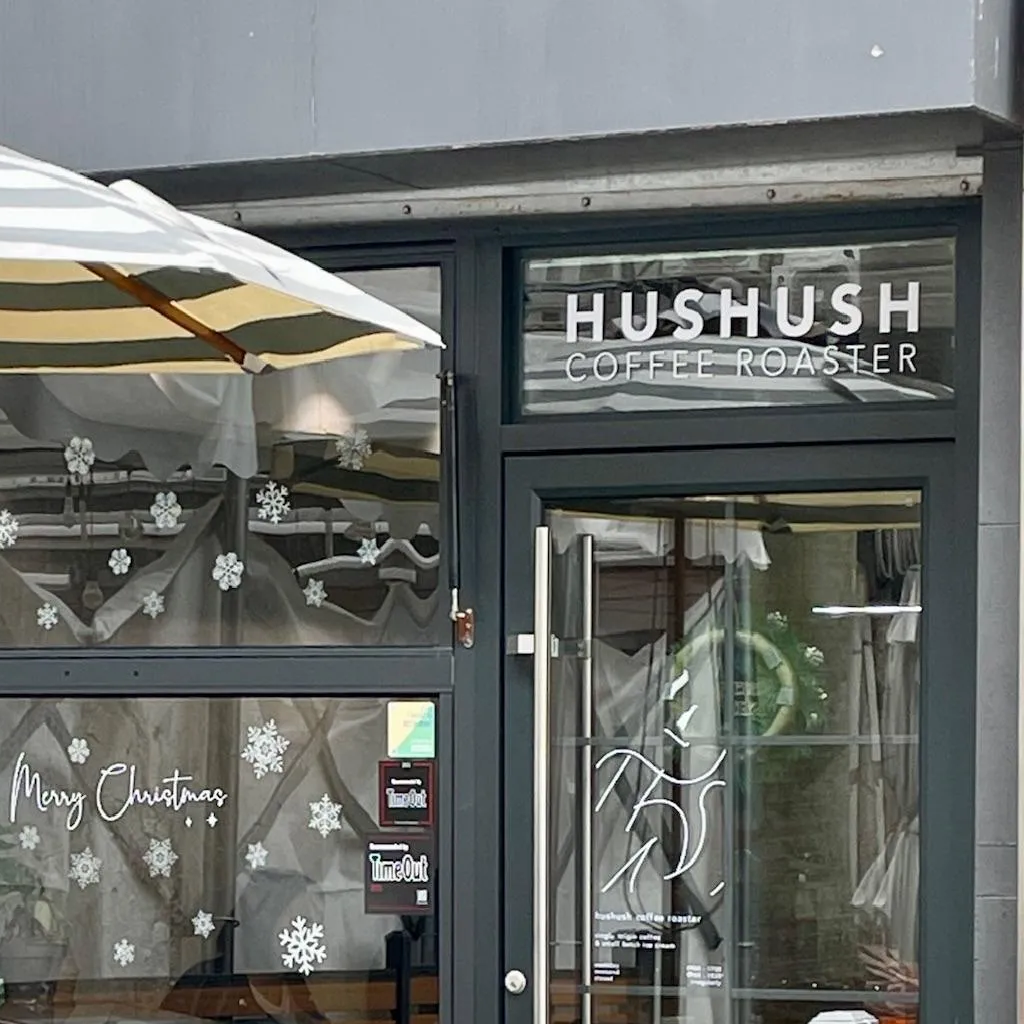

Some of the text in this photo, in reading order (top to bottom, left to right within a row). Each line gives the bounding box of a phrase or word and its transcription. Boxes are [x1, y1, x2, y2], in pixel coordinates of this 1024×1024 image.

[566, 282, 919, 342] HUSHUSH
[566, 343, 917, 382] COFFEE ROASTER
[10, 751, 228, 831] Merry Christmas
